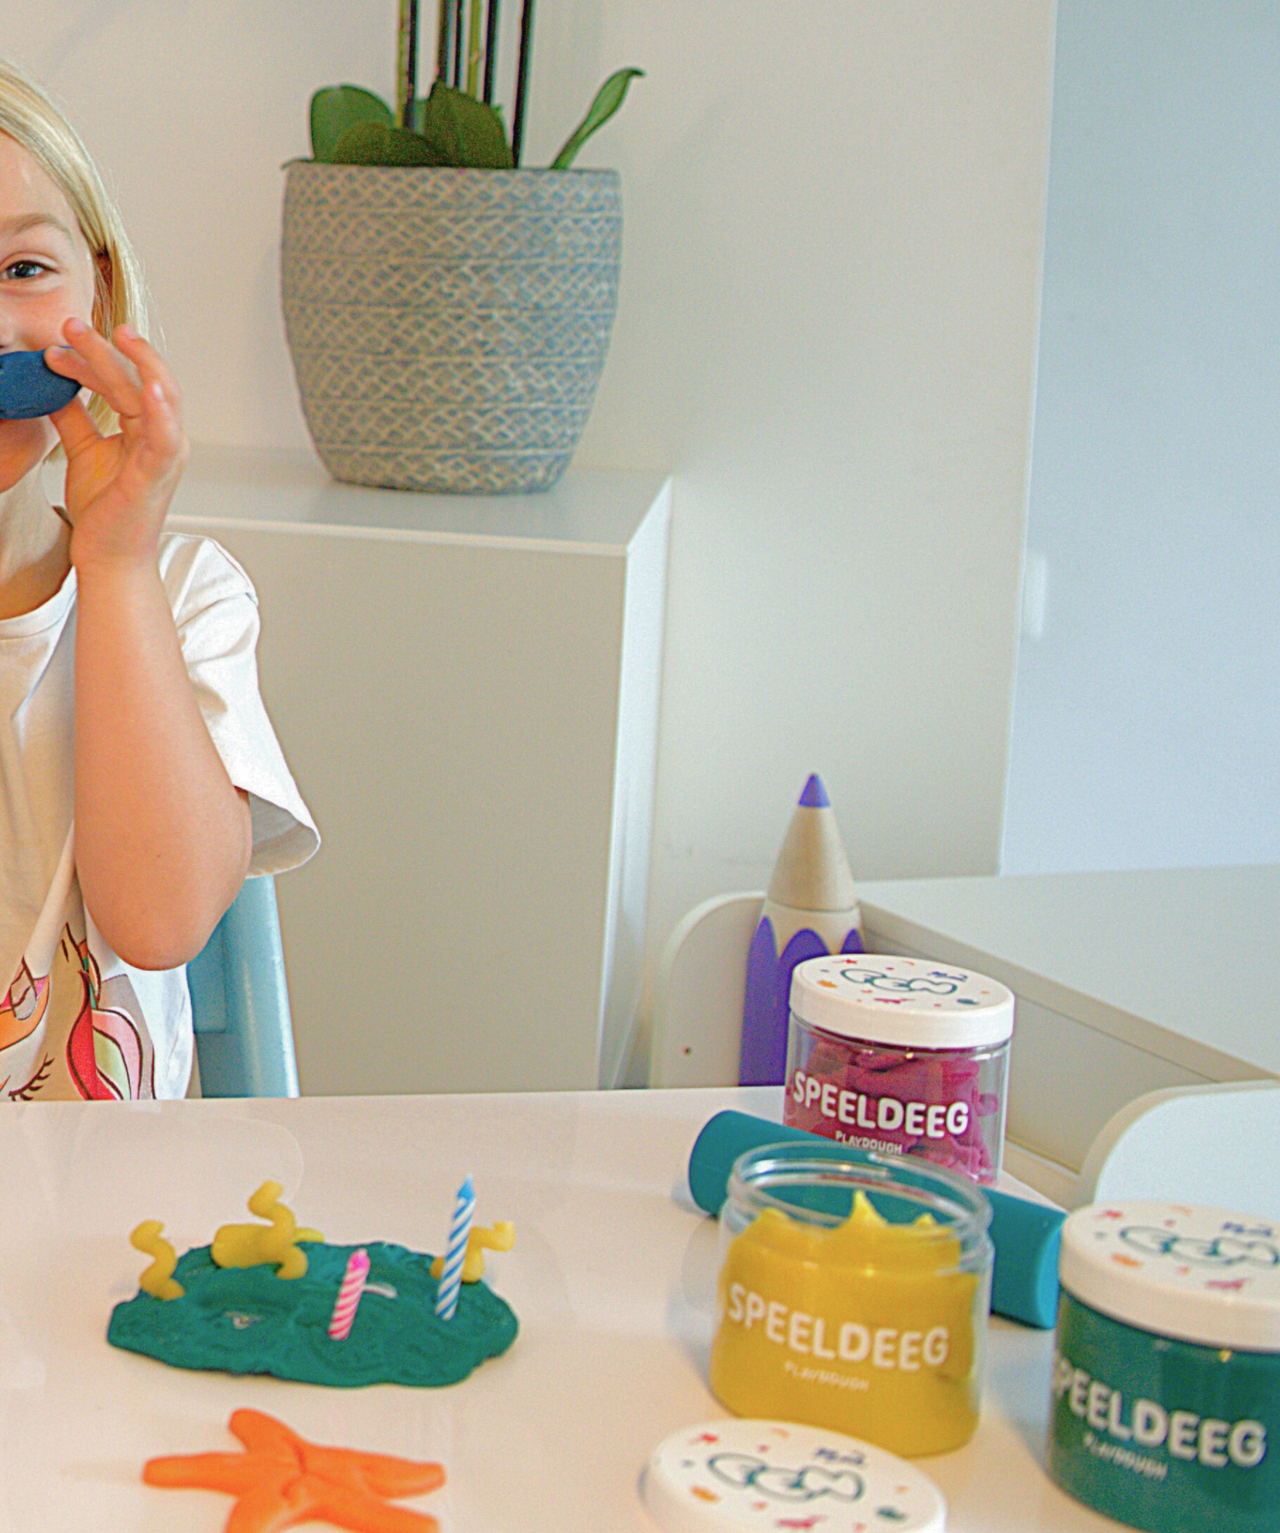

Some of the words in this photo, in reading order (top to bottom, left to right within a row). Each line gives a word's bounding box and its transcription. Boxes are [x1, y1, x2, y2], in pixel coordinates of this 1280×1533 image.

[793, 1071, 970, 1138] SPEELDEEG
[835, 1130, 903, 1155] PLAYDOUGH
[728, 1283, 949, 1371] SPEELDEEG
[1051, 1357, 1266, 1467] PEELDEEG
